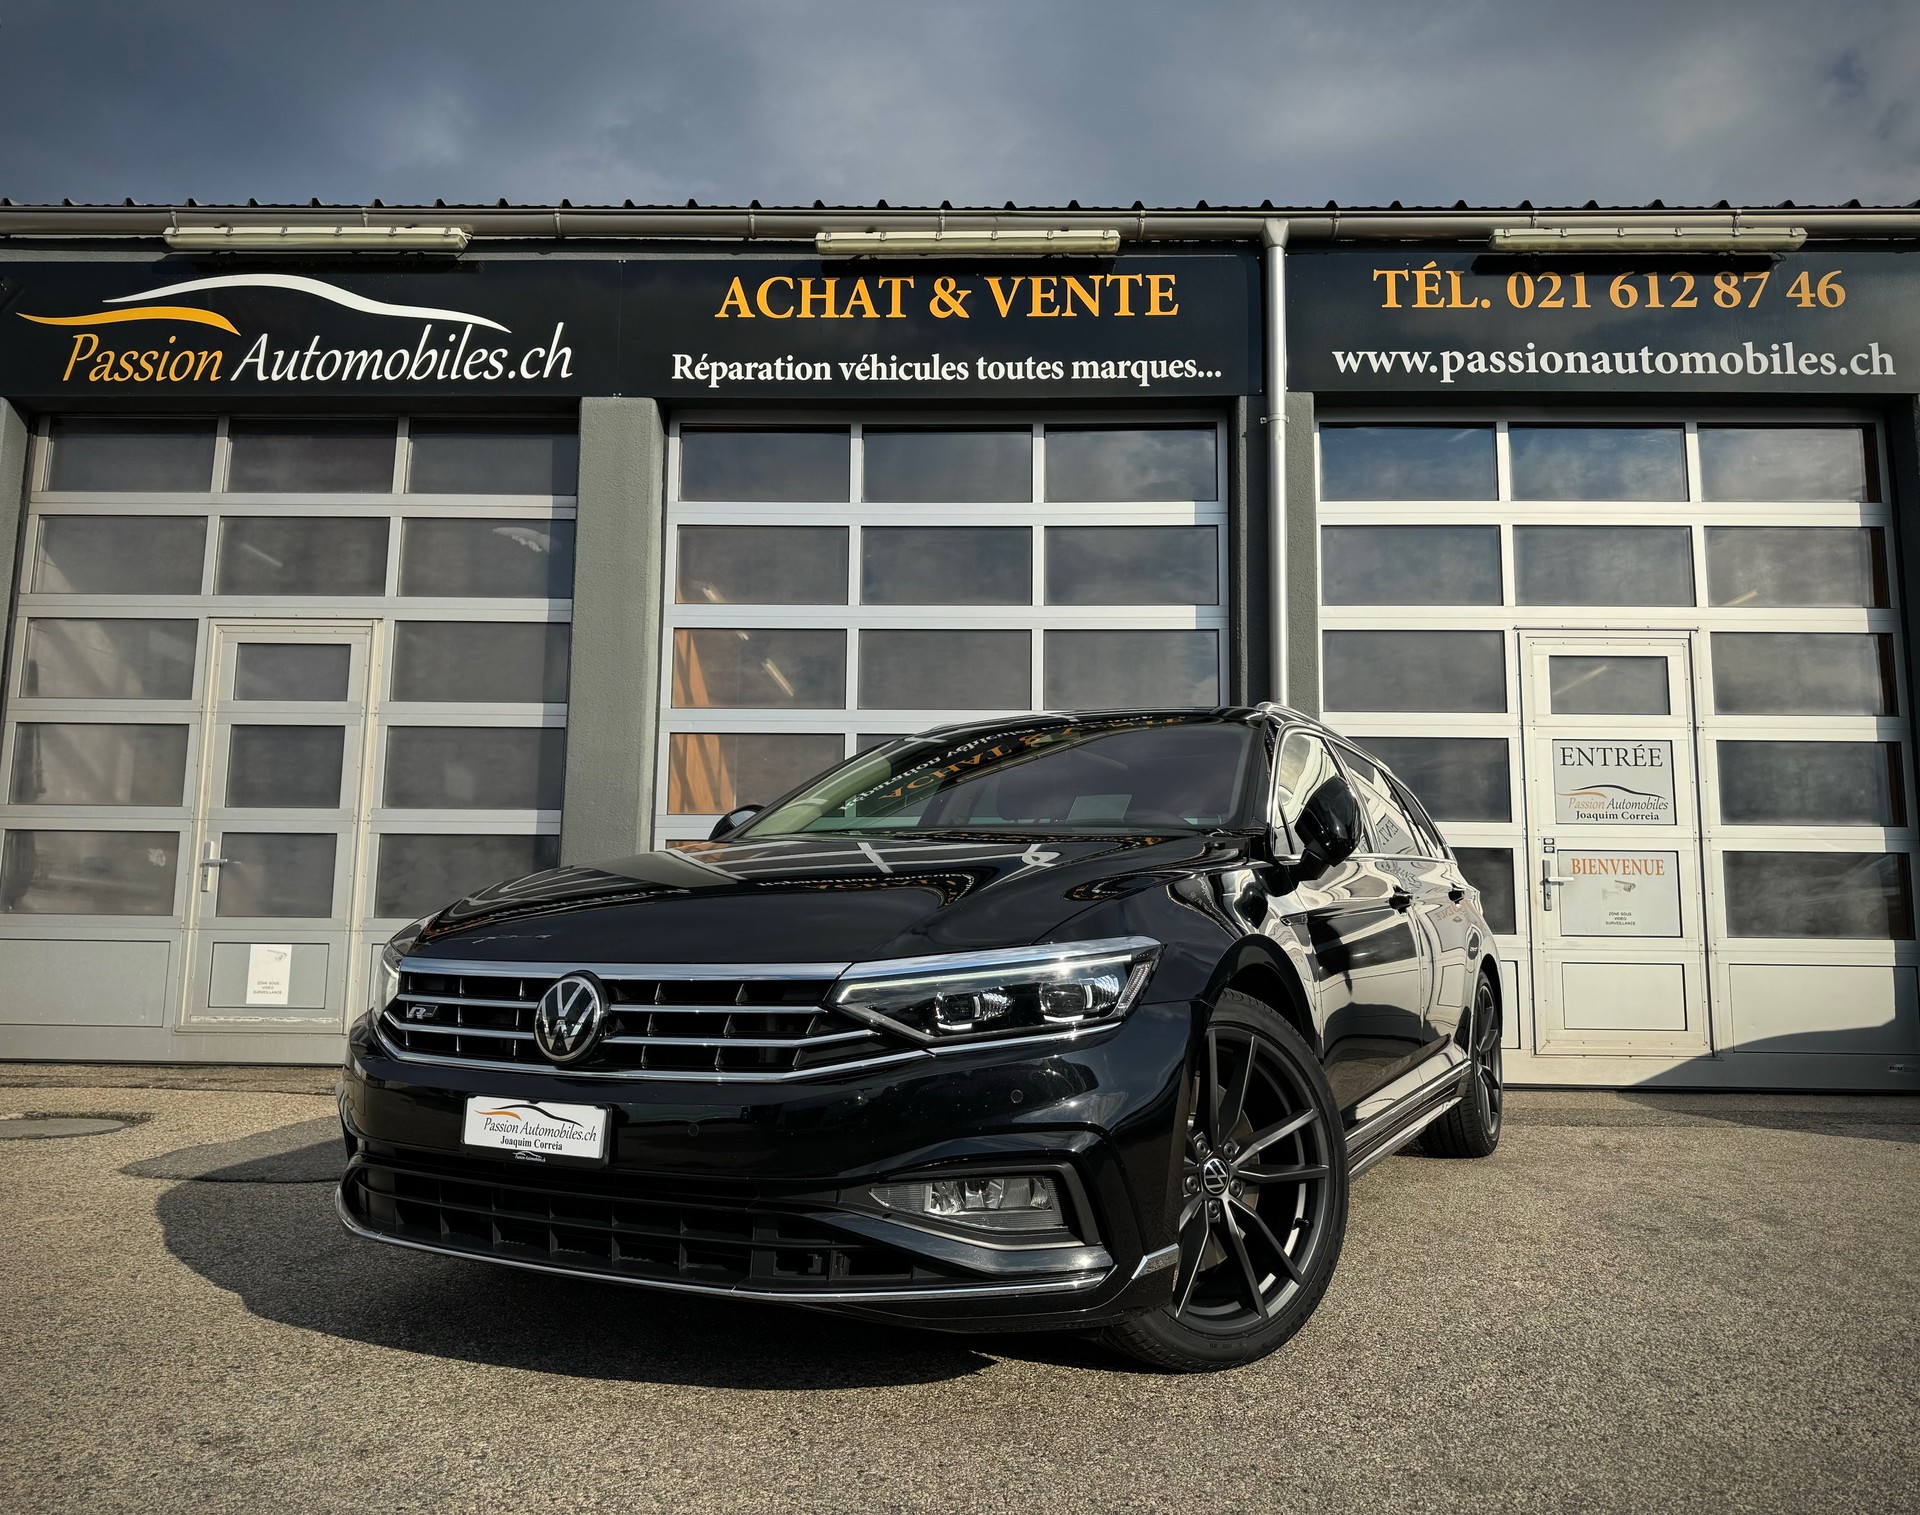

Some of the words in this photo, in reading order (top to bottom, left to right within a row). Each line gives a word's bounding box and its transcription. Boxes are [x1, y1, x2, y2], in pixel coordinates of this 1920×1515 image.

[714, 275, 915, 319] ACHAT
[928, 275, 972, 318] &
[982, 273, 1180, 317] VENTE
[1372, 260, 1491, 309] TÉL.
[1506, 270, 1592, 309] 021
[1608, 270, 1699, 309] 612
[1713, 270, 1771, 309] 87
[1785, 269, 1847, 308] 46
[62, 333, 223, 382] Passion
[230, 321, 573, 382] Automobiles.ch
[1331, 341, 1897, 383] www.passionautomobiles.ch
[671, 353, 833, 389] Réparation
[838, 352, 970, 382] véhicules
[975, 356, 1065, 381] toutes
[1070, 355, 1222, 388] marques...
[1560, 743, 1664, 768] ENTRÉE
[1568, 797, 1605, 810] Passion
[1606, 797, 1669, 811] Automobiles
[1575, 811, 1619, 821] Joaquim
[1621, 811, 1660, 821] Correia
[1570, 857, 1665, 877] BIENVENUE
[483, 1117, 519, 1135] Passion
[520, 1120, 597, 1142] Automobiles.ch
[500, 1135, 532, 1149] Joaquim
[534, 1138, 564, 1151] Correia
